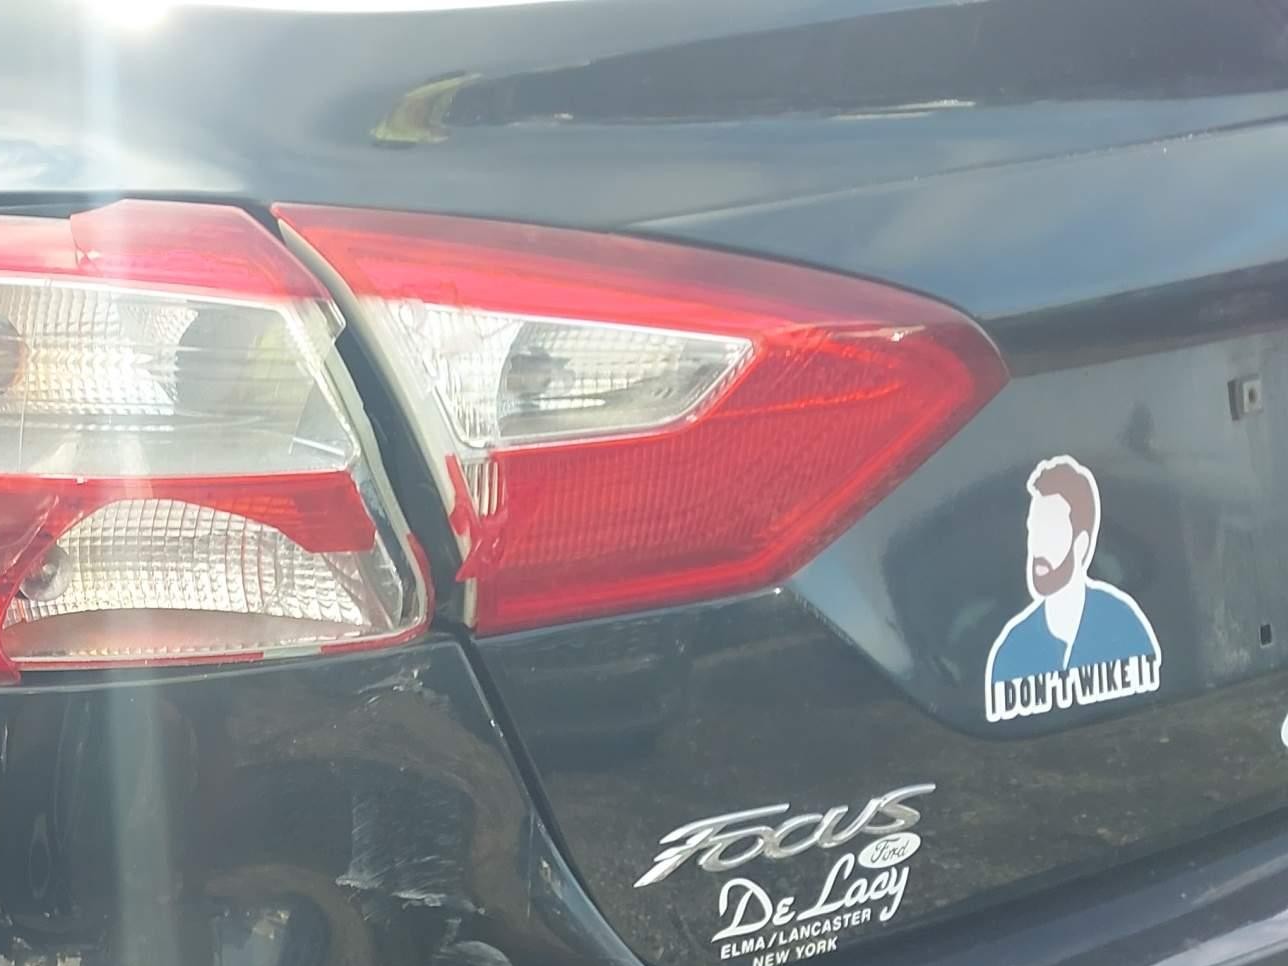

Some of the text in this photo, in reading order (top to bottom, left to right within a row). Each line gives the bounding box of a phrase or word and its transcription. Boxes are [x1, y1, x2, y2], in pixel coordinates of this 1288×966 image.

[1078, 657, 1131, 697] WIKE
[1138, 652, 1157, 686] IT
[870, 837, 910, 864] Ford
[720, 908, 872, 961] ELMA/LANCASTER
[795, 936, 838, 960] YORK
